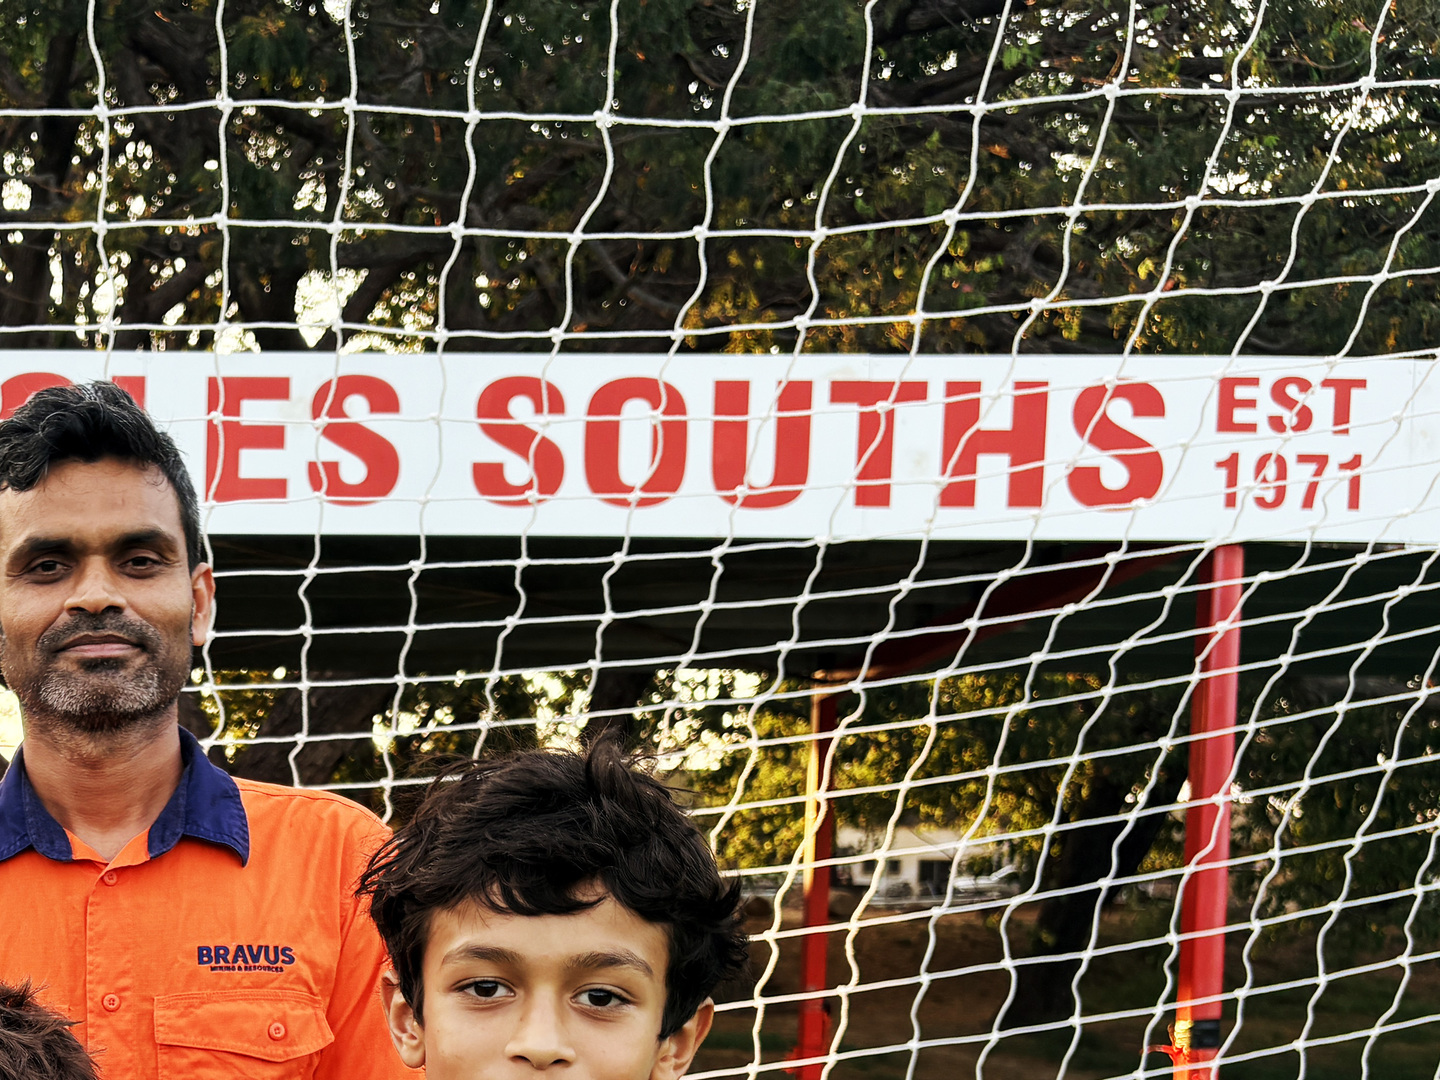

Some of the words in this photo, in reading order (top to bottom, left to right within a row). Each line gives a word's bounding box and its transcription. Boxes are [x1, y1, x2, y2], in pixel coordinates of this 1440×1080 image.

[1216, 376, 1367, 435] EST
[471, 375, 1166, 511] SOUTHS
[1214, 452, 1362, 510] 1971
[197, 944, 296, 965] BRAVUS
